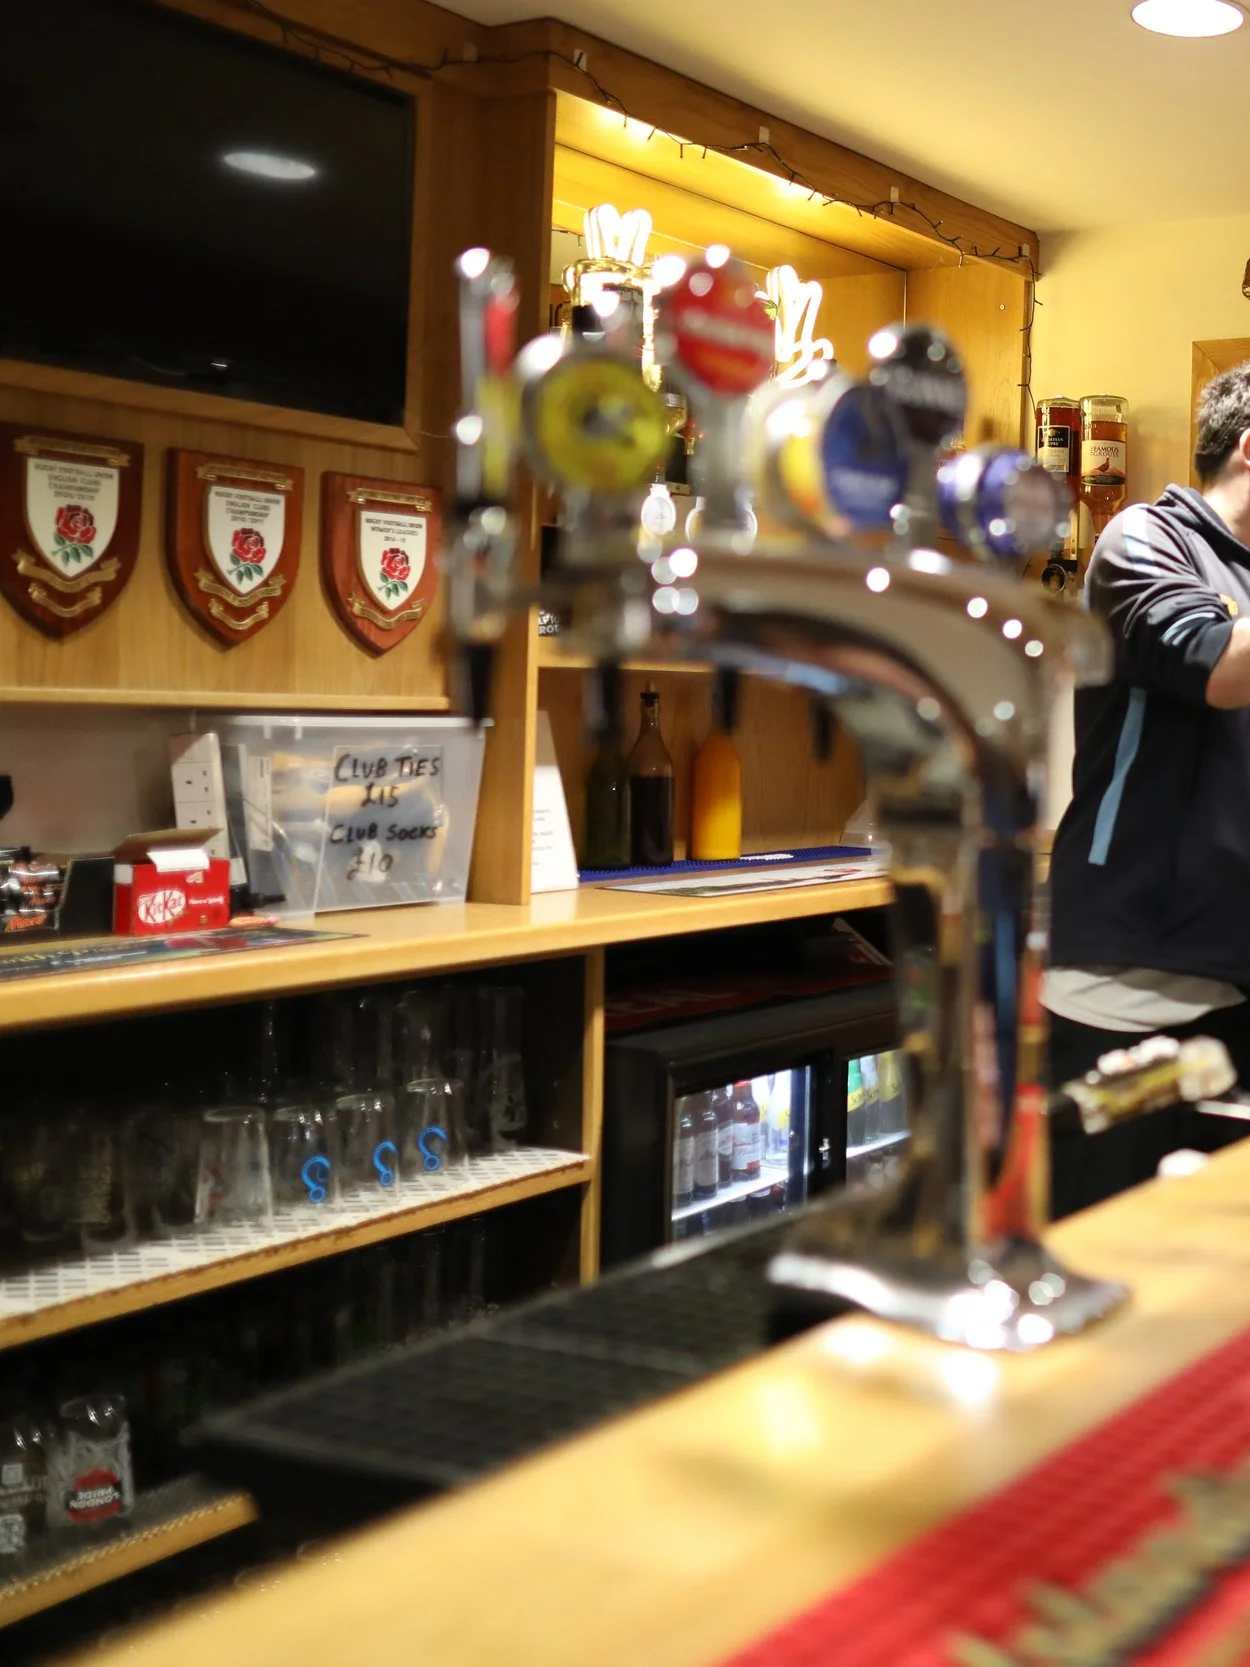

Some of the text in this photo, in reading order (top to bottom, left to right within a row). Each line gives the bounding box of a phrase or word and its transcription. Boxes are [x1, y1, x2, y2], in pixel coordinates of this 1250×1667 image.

[1093, 445, 1120, 453] FAMOUS
[335, 754, 388, 782] CLUB
[361, 782, 399, 808] £15
[329, 822, 378, 844] CLUB
[144, 891, 184, 922] KitKat
[69, 1492, 120, 1509] LONDON
[77, 1486, 112, 1500] PRIDE
